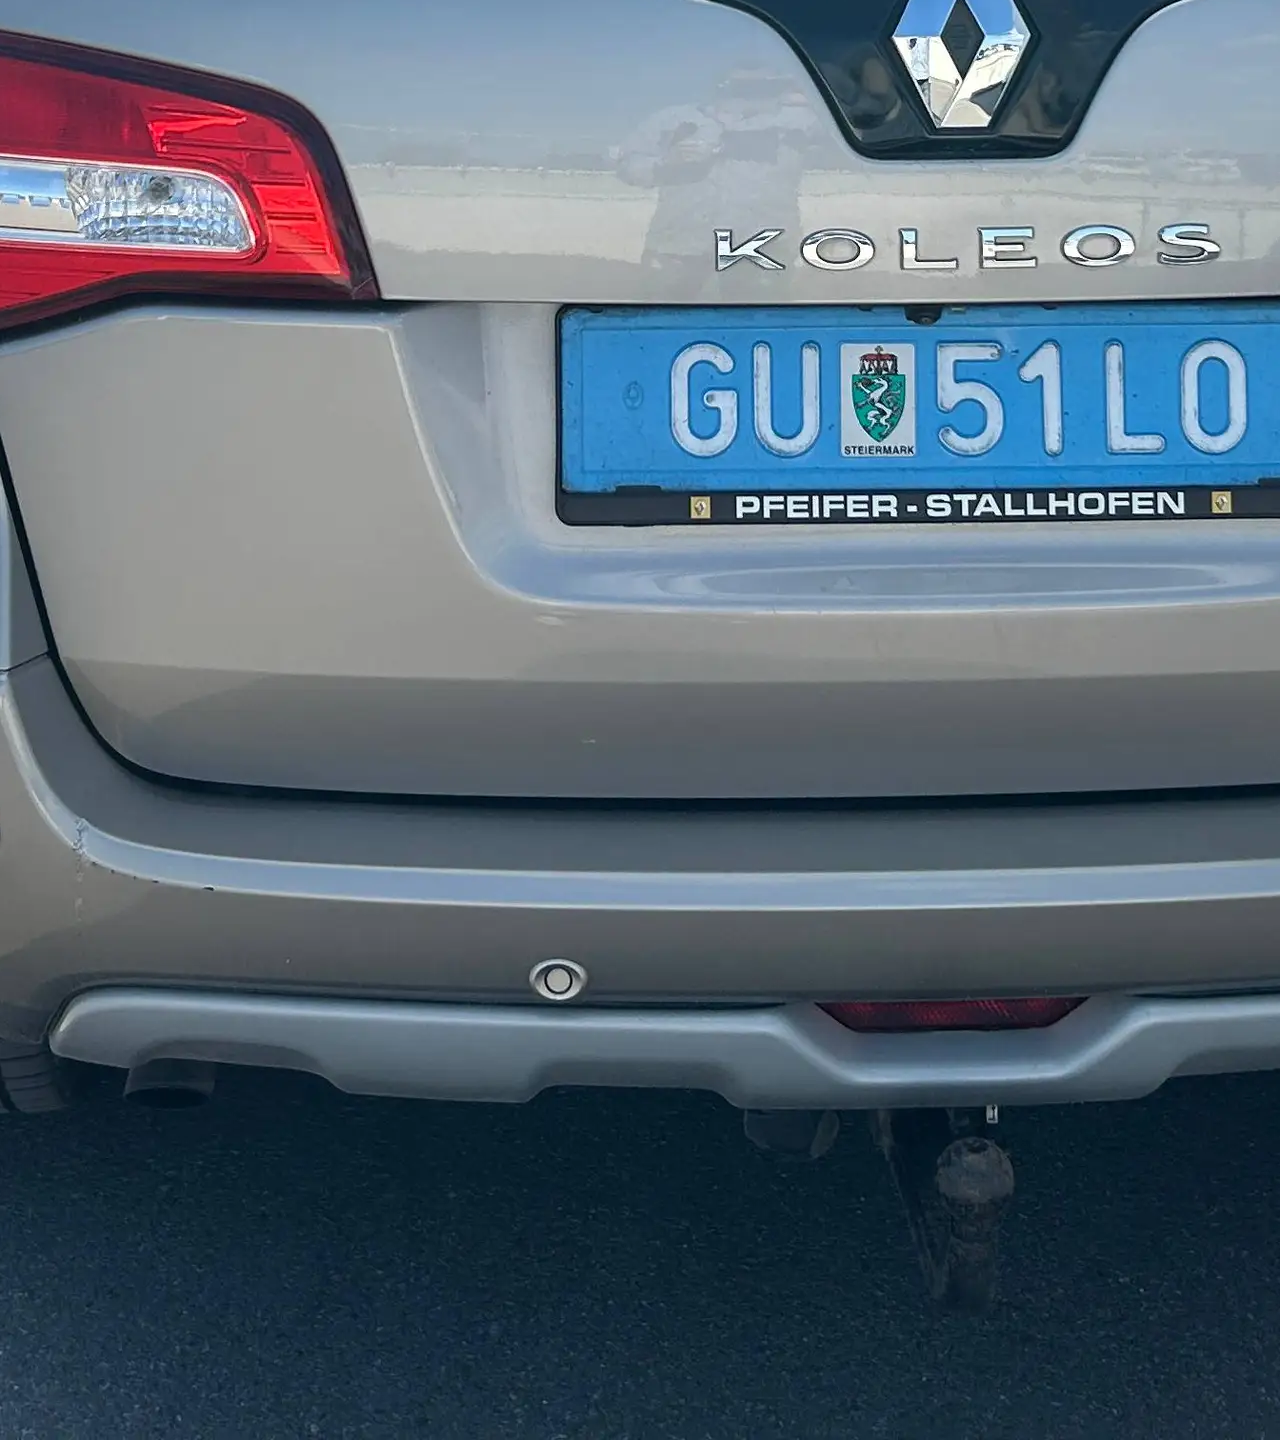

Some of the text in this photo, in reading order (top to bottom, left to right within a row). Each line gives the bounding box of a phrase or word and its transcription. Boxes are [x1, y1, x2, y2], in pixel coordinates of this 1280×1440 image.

[714, 223, 1222, 272] KOLEOS
[670, 341, 822, 458] GU
[844, 445, 915, 456] STEIERMARK
